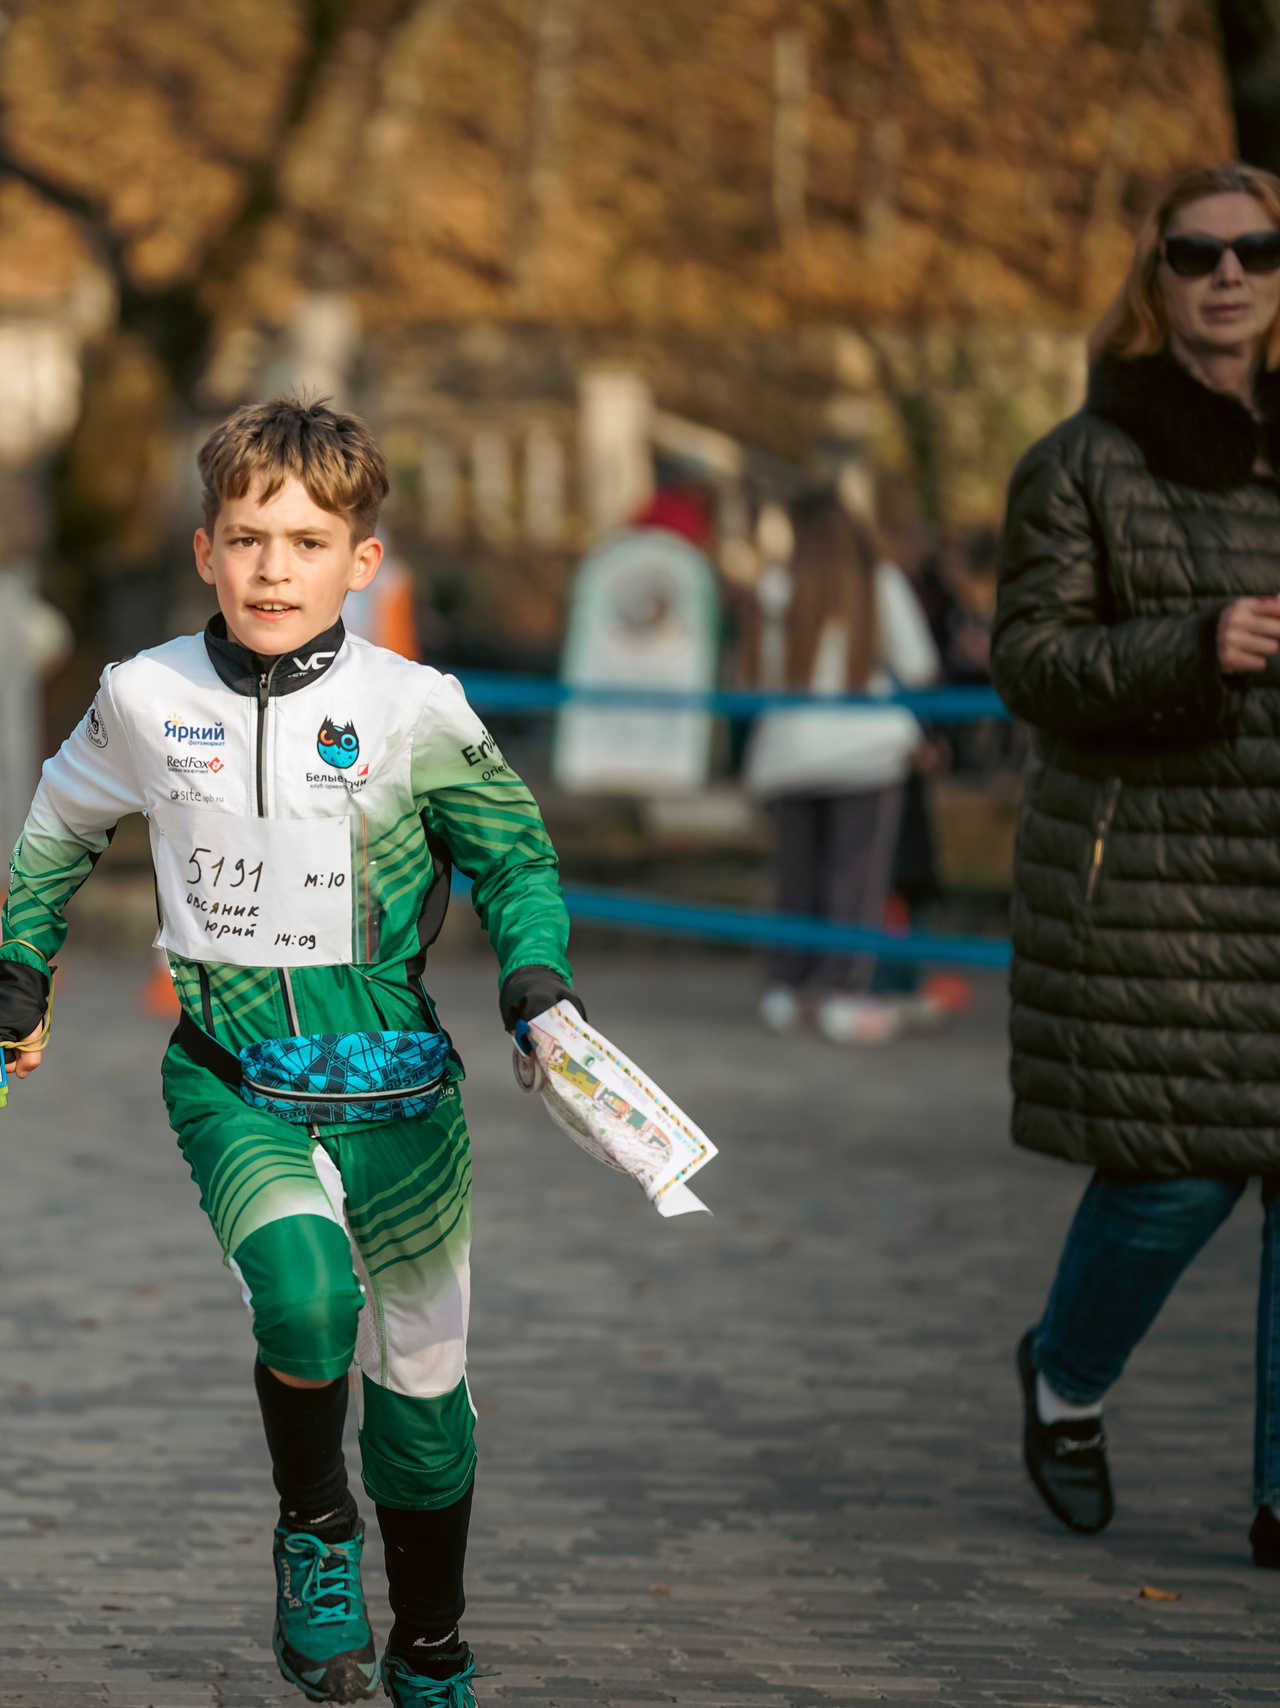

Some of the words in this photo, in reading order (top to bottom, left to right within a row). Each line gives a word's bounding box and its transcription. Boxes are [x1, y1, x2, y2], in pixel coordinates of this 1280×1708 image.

[164, 720, 224, 742] Яркий
[306, 773, 344, 783] Белые
[186, 848, 263, 893] 5191
[274, 933, 317, 950] 14:09
